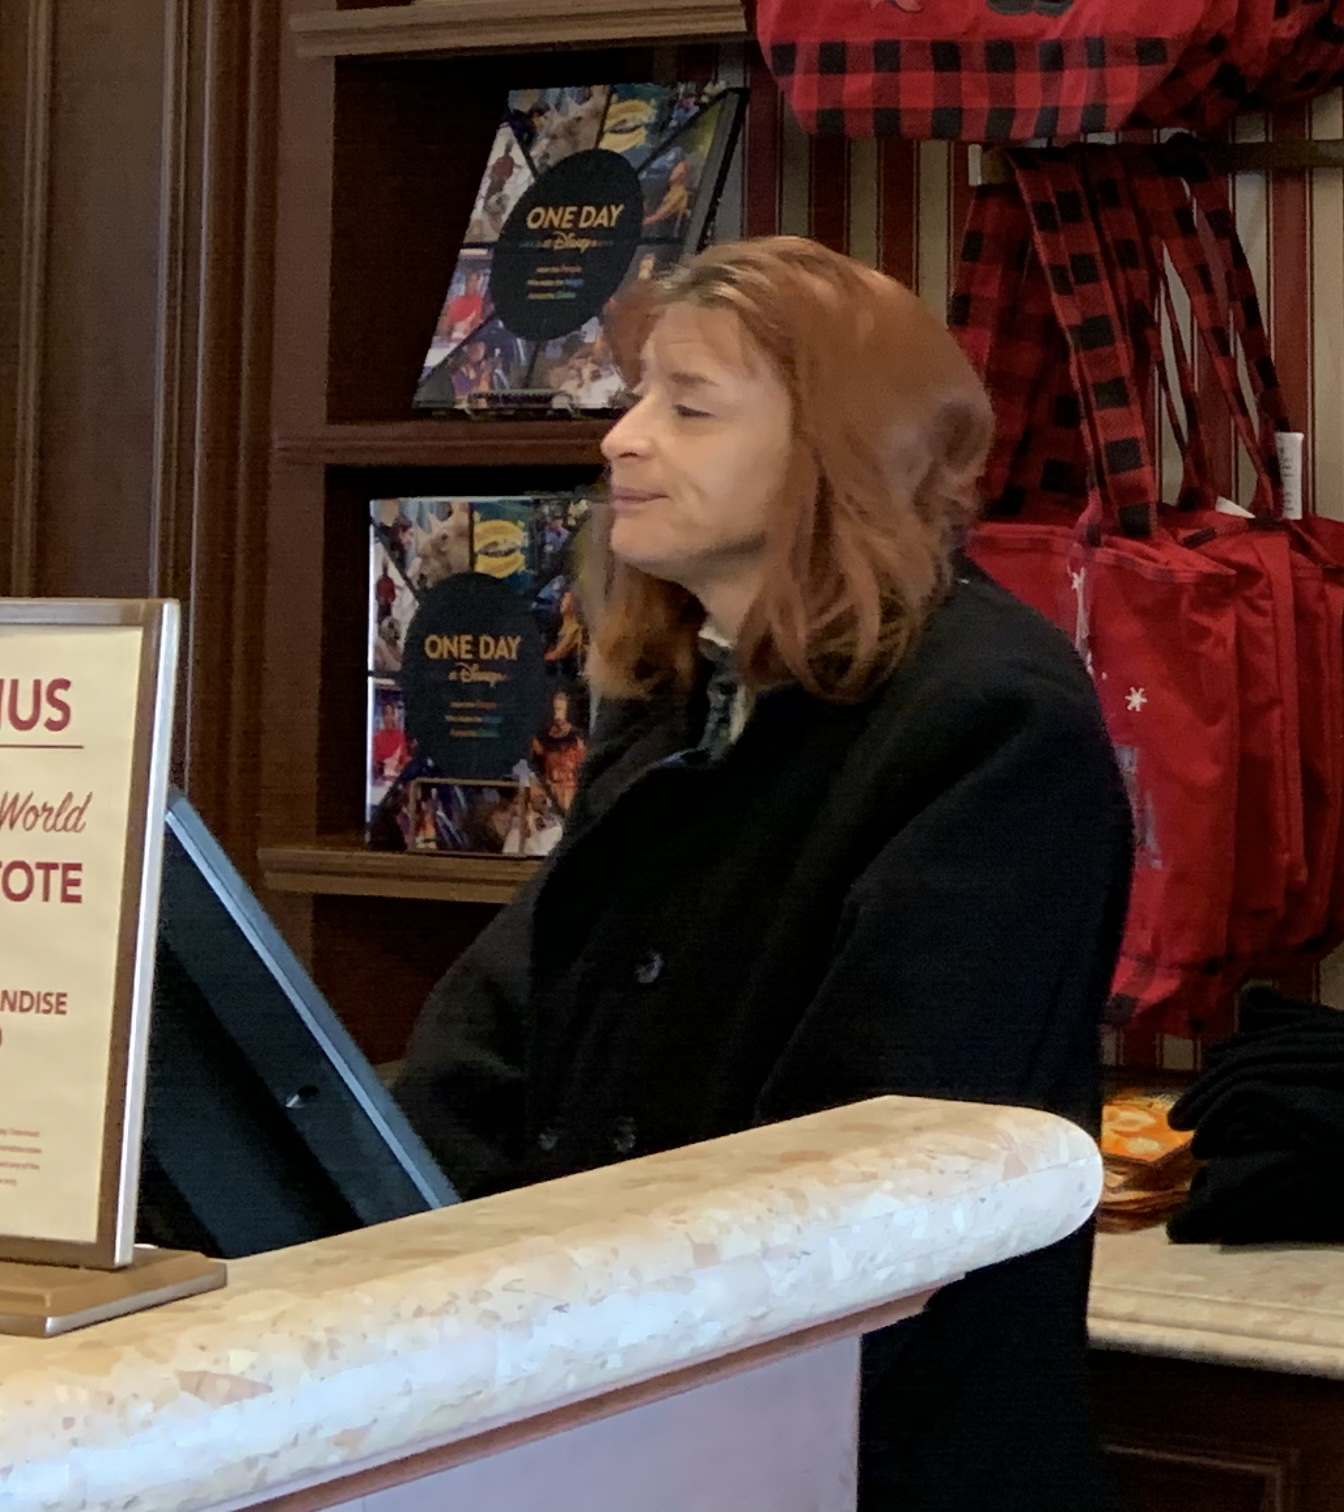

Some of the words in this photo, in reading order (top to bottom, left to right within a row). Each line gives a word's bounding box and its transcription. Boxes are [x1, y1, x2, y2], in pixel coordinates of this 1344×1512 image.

[526, 206, 578, 229] ONE
[578, 204, 625, 228] DAY
[424, 634, 473, 659] ONE
[479, 634, 521, 660] DAY
[0, 678, 72, 731] US
[0, 791, 93, 833] World
[0, 860, 83, 903] OTE
